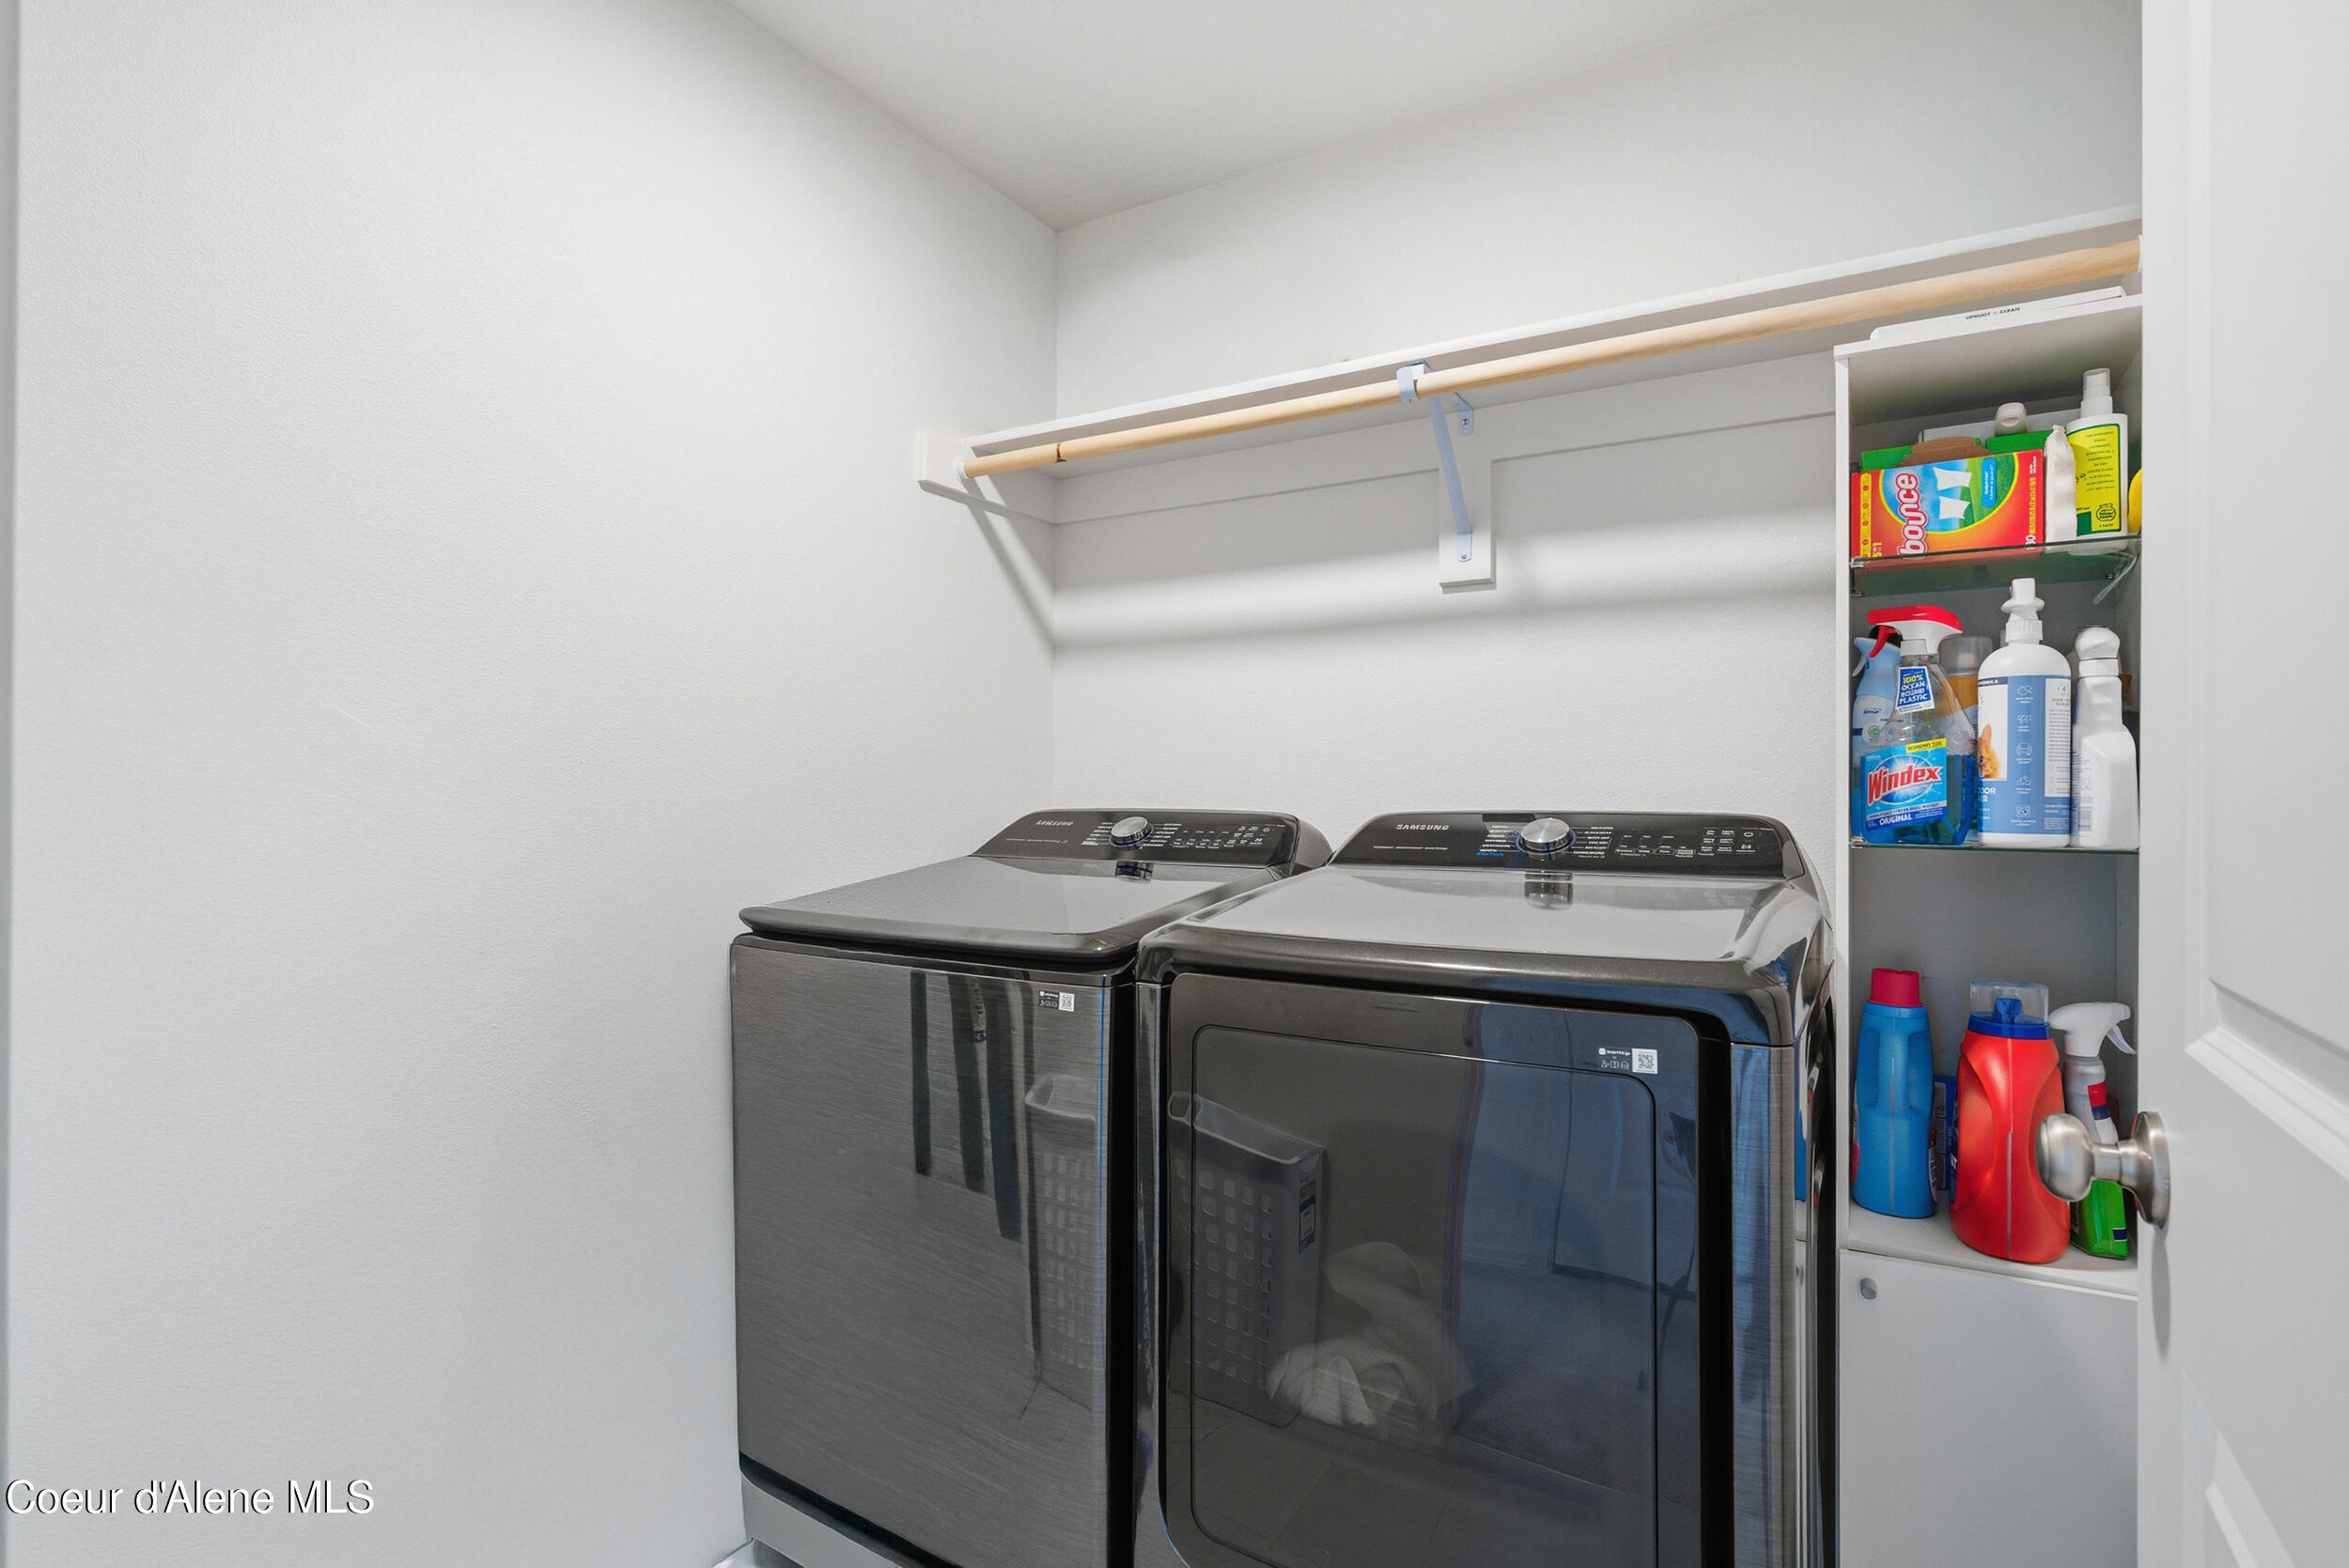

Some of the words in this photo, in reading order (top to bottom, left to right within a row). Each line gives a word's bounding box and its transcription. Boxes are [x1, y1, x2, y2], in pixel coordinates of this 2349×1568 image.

[1999, 306, 2021, 315] CLEAN
[1897, 473, 1928, 558] bounce
[1903, 674, 1923, 684] 100%
[1901, 680, 1925, 691] OCEAN
[1899, 693, 1927, 705] PLASTIC
[1868, 764, 1943, 806] Windex
[1879, 814, 1913, 826] ORIGINAL
[1395, 823, 1450, 831] SAMSUNG
